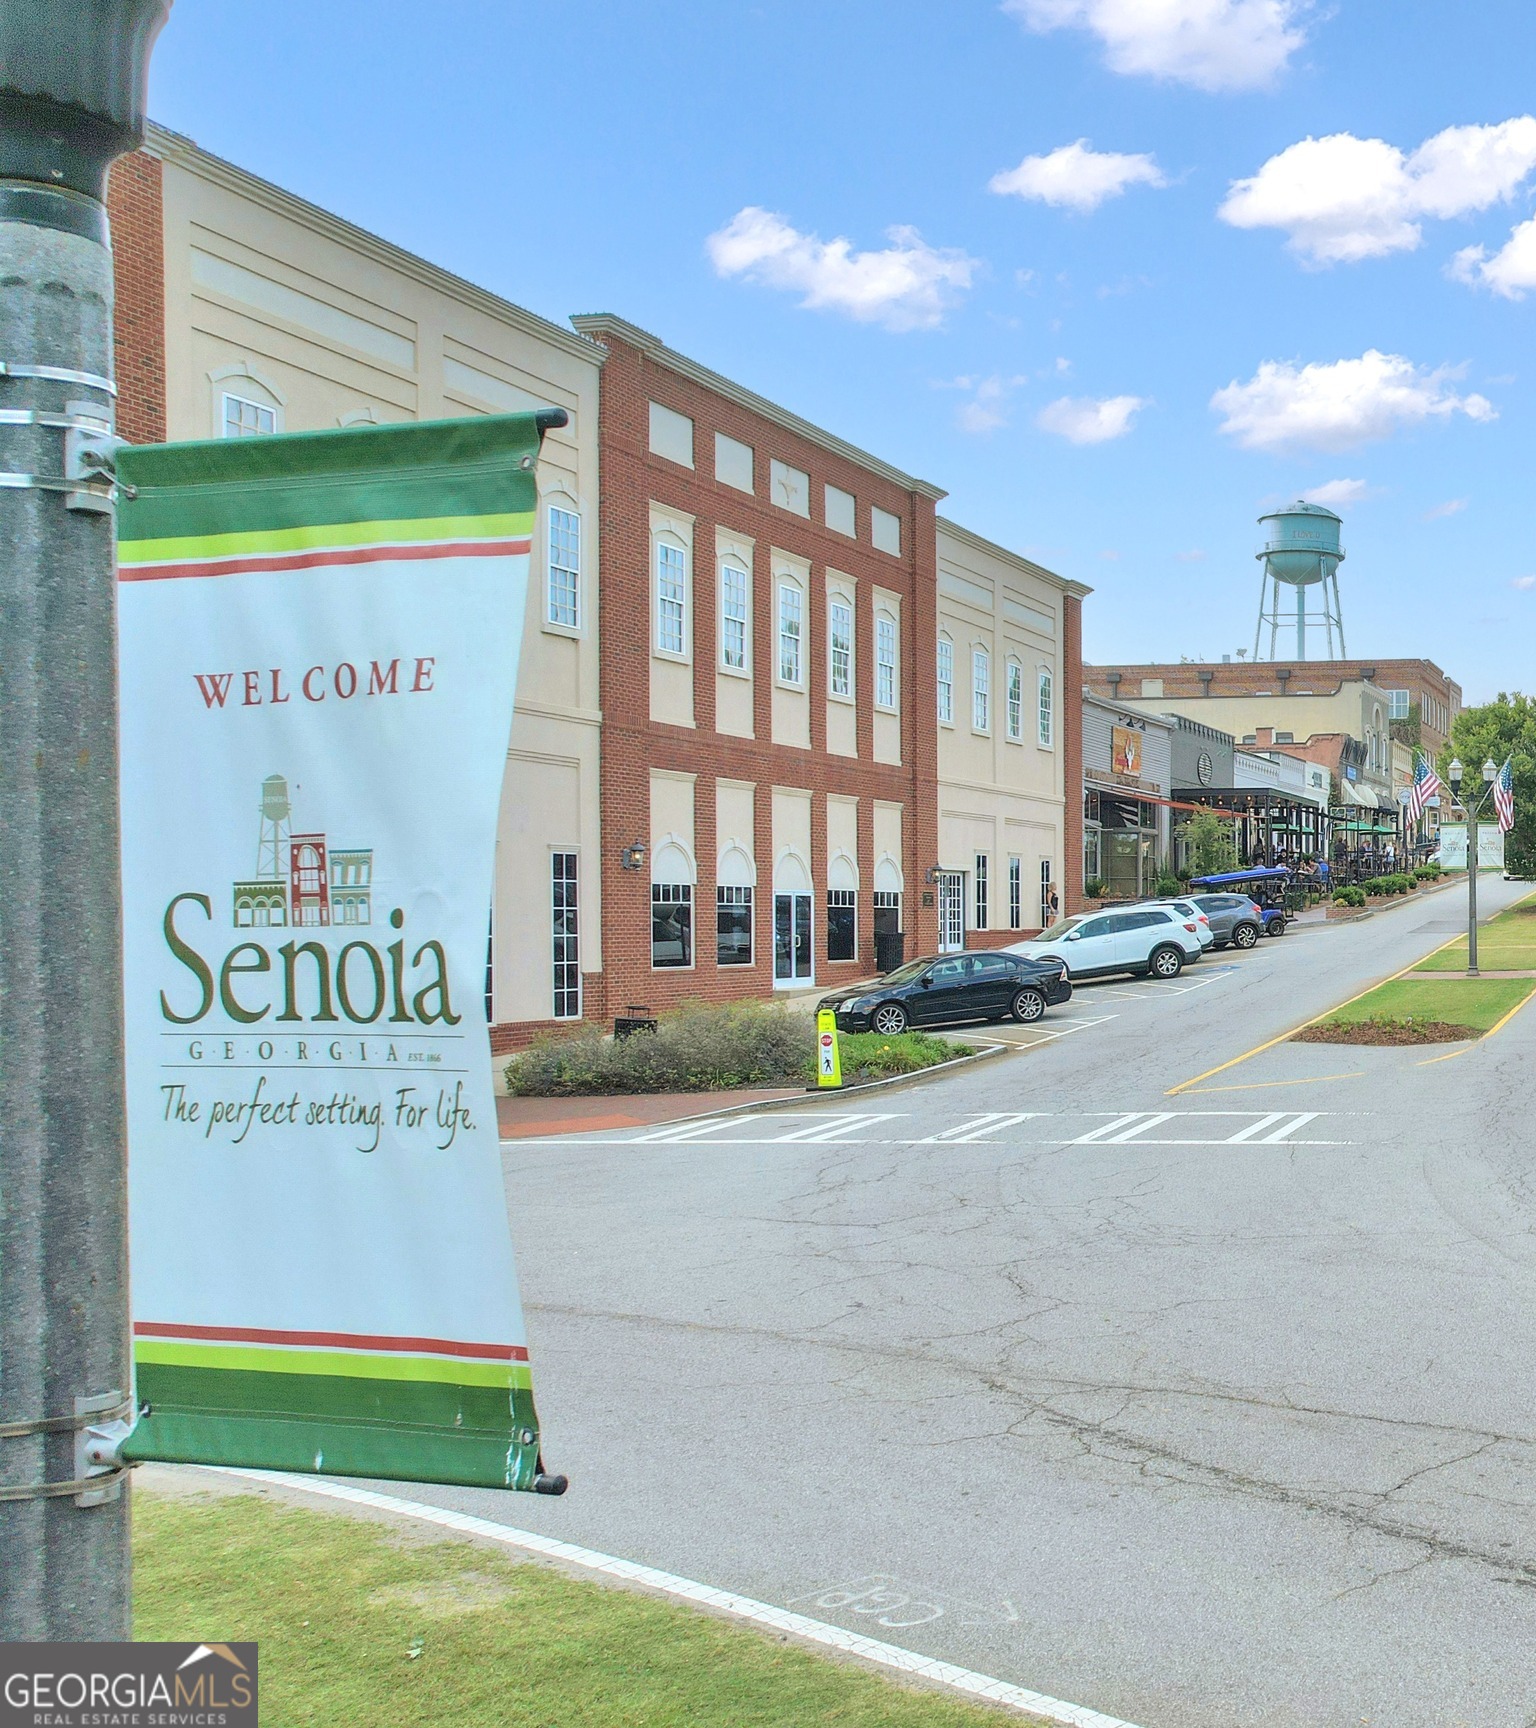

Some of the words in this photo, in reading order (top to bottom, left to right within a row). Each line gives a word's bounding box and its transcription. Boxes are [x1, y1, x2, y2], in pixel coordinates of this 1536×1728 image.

[193, 657, 436, 709] WELCOME
[160, 892, 462, 1026] Senoia
[160, 1084, 201, 1122] The
[206, 1076, 300, 1143] perfect
[305, 1093, 385, 1153] setting.
[396, 1087, 428, 1128] For
[436, 1080, 477, 1150] life.
